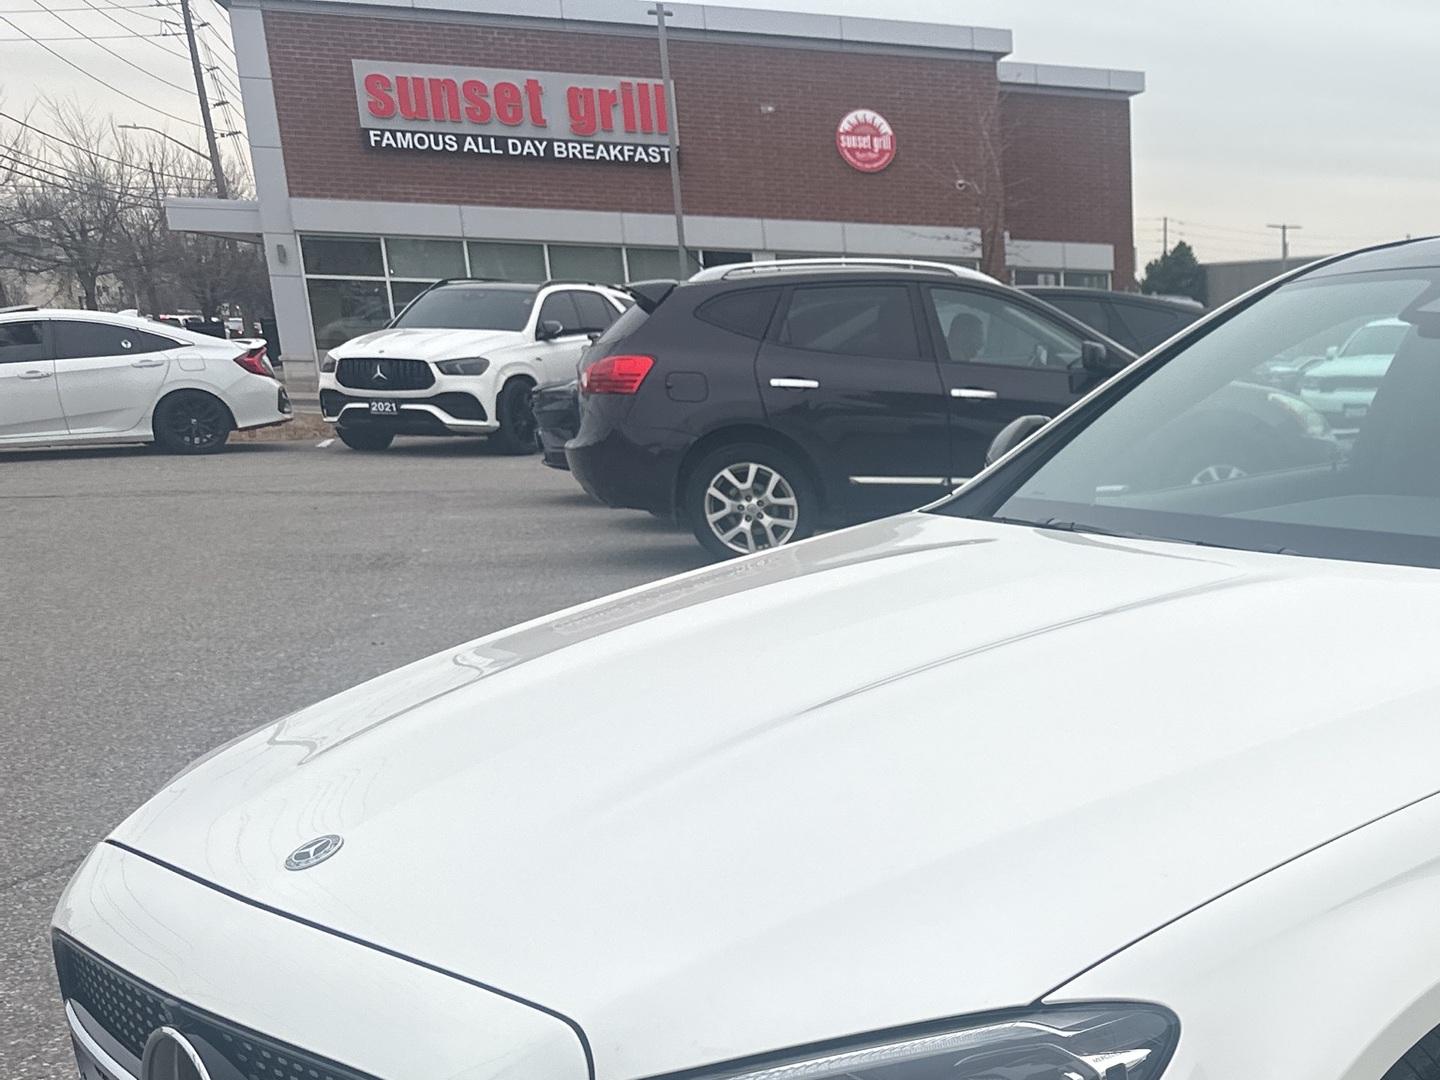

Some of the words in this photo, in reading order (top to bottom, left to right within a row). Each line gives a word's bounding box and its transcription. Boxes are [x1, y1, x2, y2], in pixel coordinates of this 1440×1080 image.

[363, 73, 548, 127] sunset
[567, 81, 669, 136] grill
[369, 130, 458, 152] FAMOUS
[463, 136, 503, 154] ALL
[507, 138, 548, 157] DAY
[553, 141, 673, 163] BREAKFAST
[840, 134, 871, 149] sunset
[872, 133, 891, 153] grill
[371, 401, 397, 412] 2021
